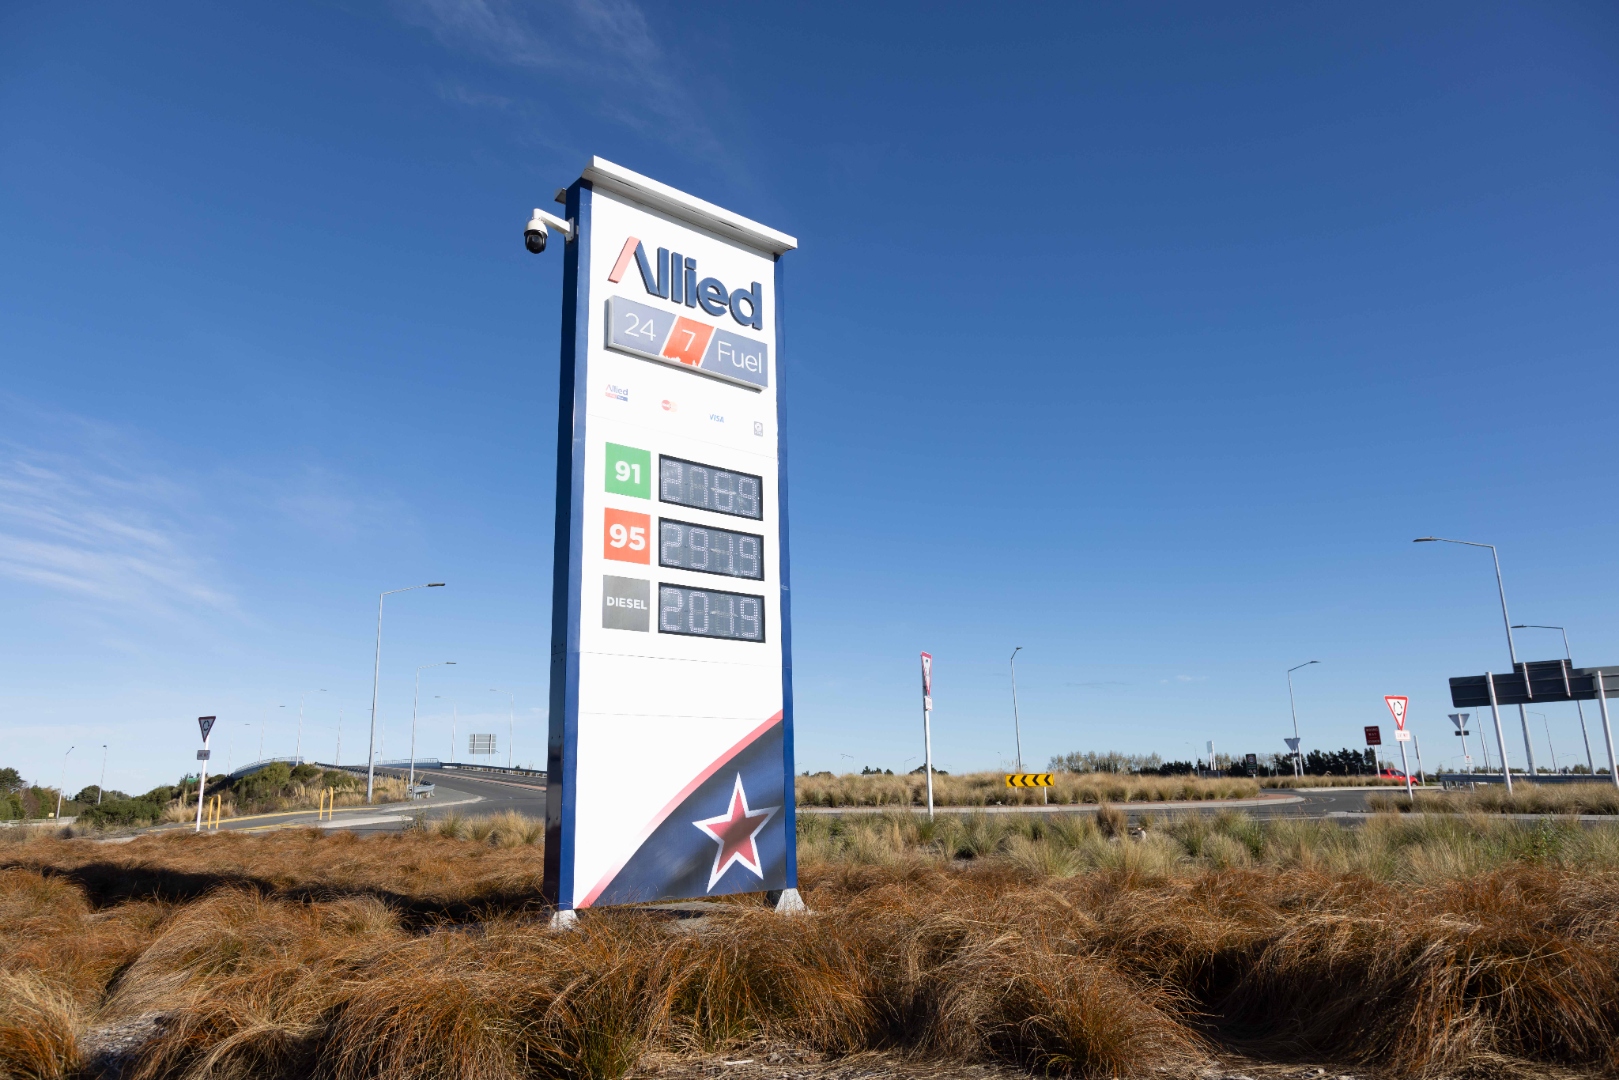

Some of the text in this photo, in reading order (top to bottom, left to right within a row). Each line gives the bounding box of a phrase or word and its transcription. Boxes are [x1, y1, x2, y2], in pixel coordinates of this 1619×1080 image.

[607, 236, 763, 331] Allied
[624, 313, 762, 374] 24 7 Fuel
[605, 384, 629, 396] Allied
[709, 413, 725, 423] VISA
[615, 460, 641, 484] 91
[609, 523, 646, 551] 95
[606, 596, 647, 610] DIESEL
